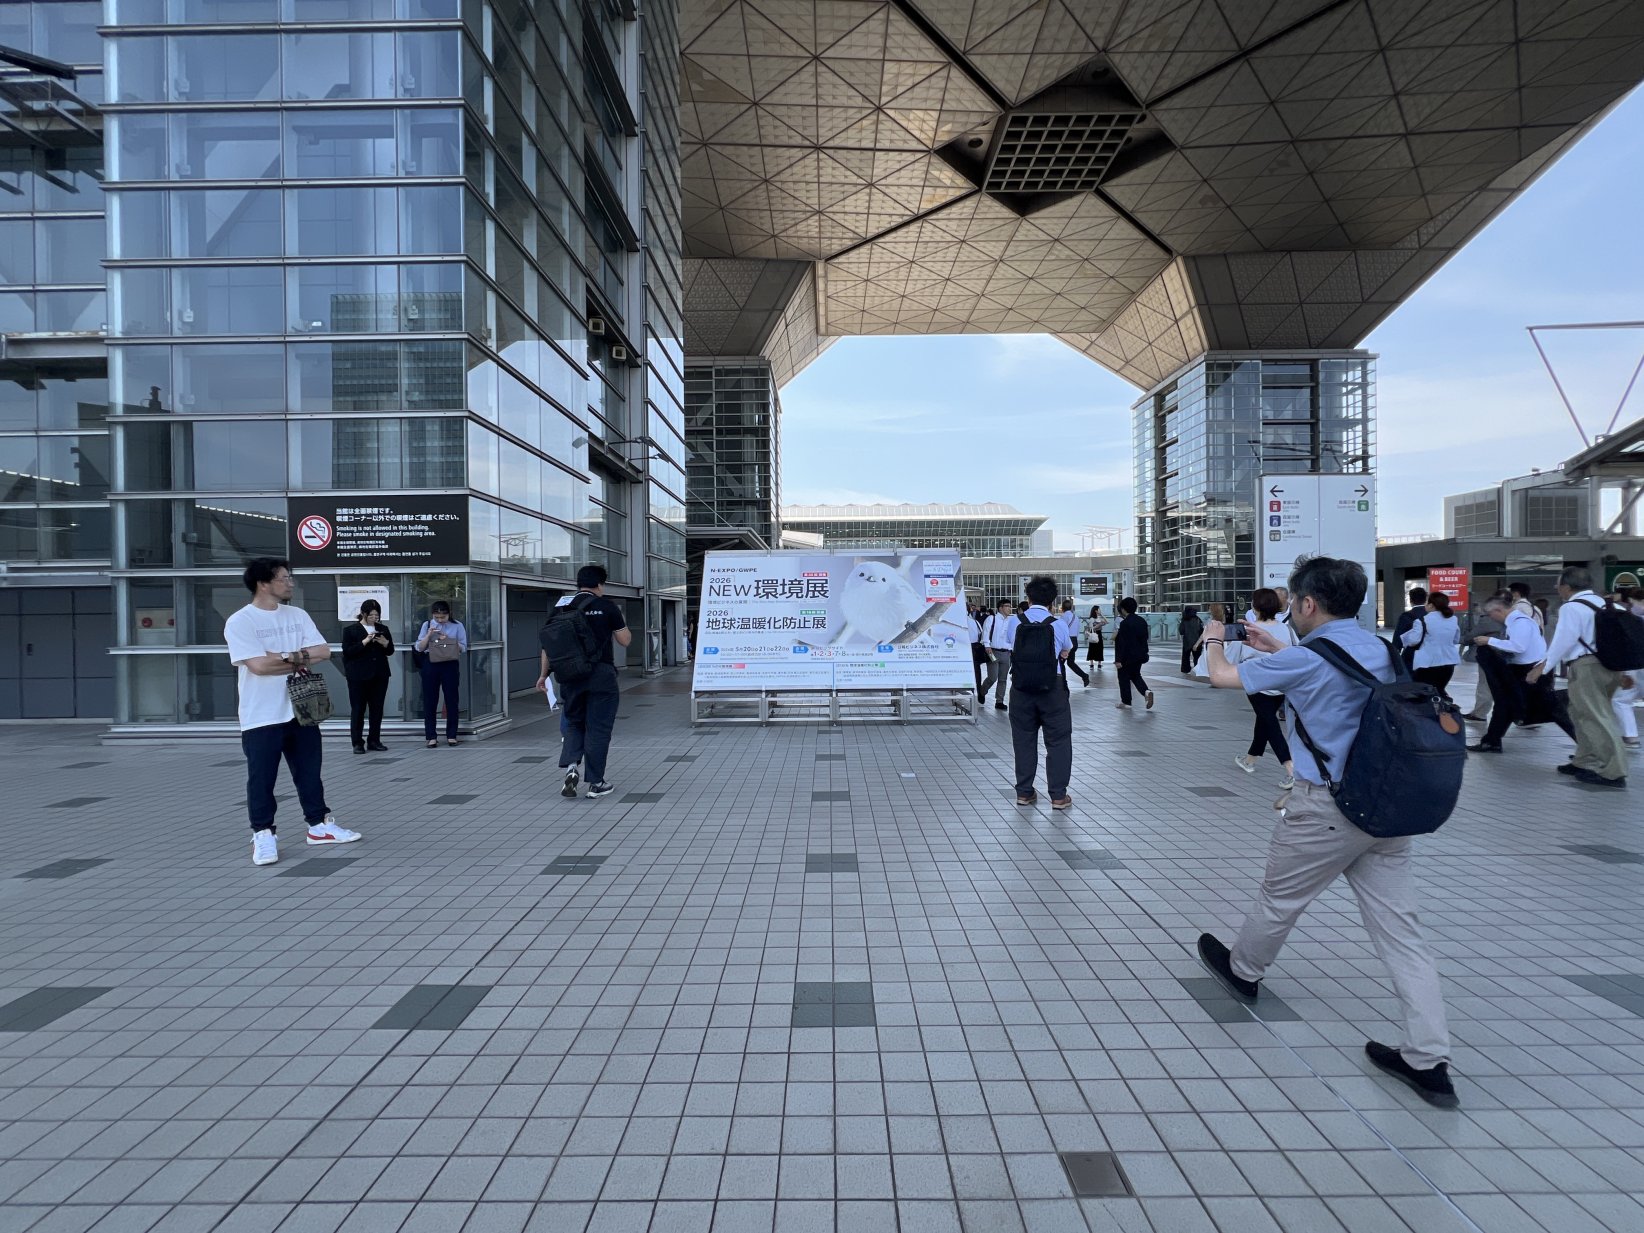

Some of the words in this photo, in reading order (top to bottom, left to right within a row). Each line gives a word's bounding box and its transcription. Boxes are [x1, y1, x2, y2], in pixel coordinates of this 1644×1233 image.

[705, 617, 827, 630] 地球温暖化防止展
